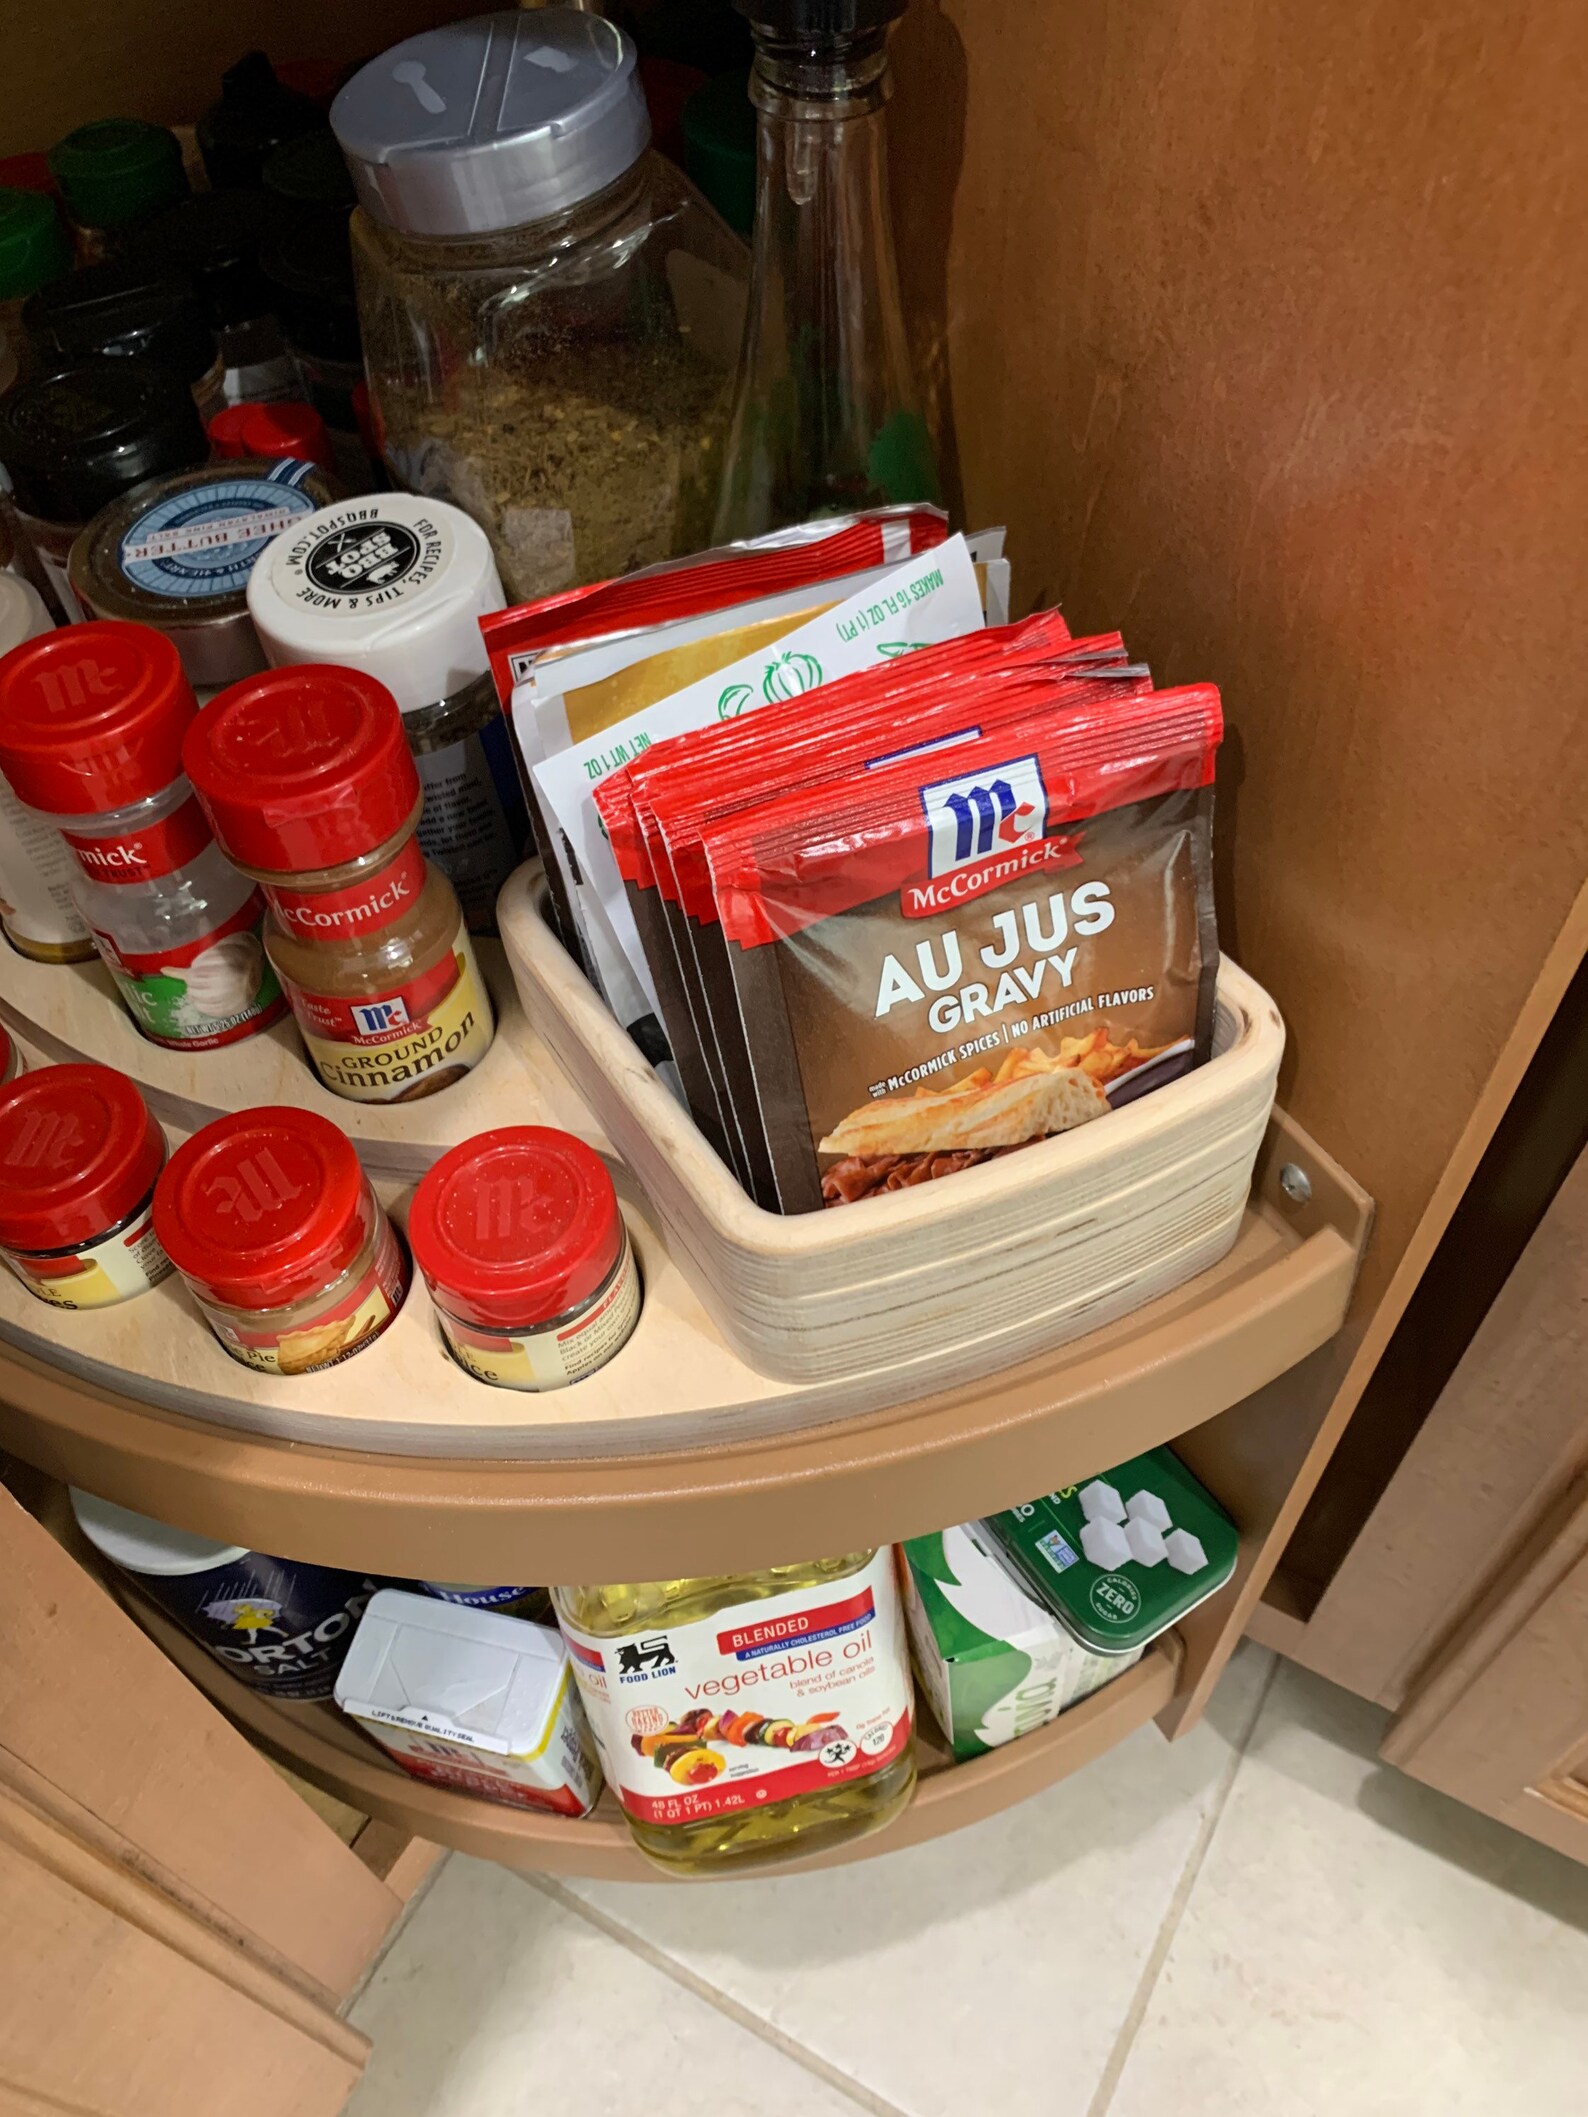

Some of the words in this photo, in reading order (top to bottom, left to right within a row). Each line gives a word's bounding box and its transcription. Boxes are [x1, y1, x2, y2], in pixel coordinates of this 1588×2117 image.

[286, 508, 379, 566] BBQSPOT.COM
[413, 518, 438, 540] FOR
[135, 531, 229, 558] BUTTER
[325, 532, 392, 576] SPOT
[340, 543, 399, 579] BBQ
[910, 568, 945, 599] MAKES
[296, 587, 342, 609] MORE
[349, 598, 359, 609] &
[367, 587, 404, 607] TIPS
[883, 597, 899, 615] FL
[896, 590, 909, 609] 16
[857, 610, 870, 632] (1
[867, 604, 885, 626] OZ
[835, 616, 860, 643] PT)
[631, 732, 653, 754] NET
[603, 755, 613, 772] 1
[609, 745, 632, 767] WT
[583, 759, 603, 780] OZ
[907, 839, 1063, 911] McCormick
[874, 930, 964, 1019] AU
[980, 880, 1116, 969] JUS
[928, 946, 1079, 1034] GRAVY
[1011, 1020, 1029, 1040] NO
[1032, 997, 1095, 1031] ARTIFICIAL
[1097, 985, 1155, 1009] FLAVORS
[352, 1022, 423, 1046] McCormick
[320, 1011, 475, 1088] Cinnamon
[341, 1026, 443, 1070] GROUND
[886, 1049, 957, 1092] McCORMICK
[960, 1032, 1001, 1061] SPICES
[868, 1081, 886, 1094] made
[871, 1087, 887, 1099] with
[249, 1348, 276, 1363] Pie
[565, 1360, 582, 1370] Find
[1096, 1582, 1135, 1615] ZERO
[1106, 1577, 1138, 1601] CALORIES
[215, 1578, 378, 1664] ORTON
[1095, 1602, 1118, 1620] SUGAR
[732, 1616, 810, 1648] BLENDED
[751, 1641, 790, 1657] NATURALLY
[790, 1629, 837, 1647] CHOLESTEROL
[838, 1624, 855, 1634] FREE
[253, 1647, 332, 1676] SALT
[684, 1651, 833, 1701] vegetable
[843, 1629, 873, 1659] oil
[790, 1673, 822, 1690] blend
[825, 1669, 836, 1681] of
[839, 1656, 875, 1676] canola
[619, 1673, 648, 1684] FOOD
[651, 1666, 677, 1679] LION
[796, 1688, 806, 1698] &
[808, 1676, 857, 1694] soybean
[424, 1724, 456, 1738] QUALITY
[457, 1732, 475, 1743] SEAL
[652, 1800, 666, 1810] 48
[668, 1798, 682, 1809] FL
[684, 1794, 700, 1806] OZ
[653, 1808, 664, 1820] (1
[666, 1808, 681, 1819] QT
[694, 1801, 712, 1814] PT)
[714, 1794, 746, 1808] 1.42L
